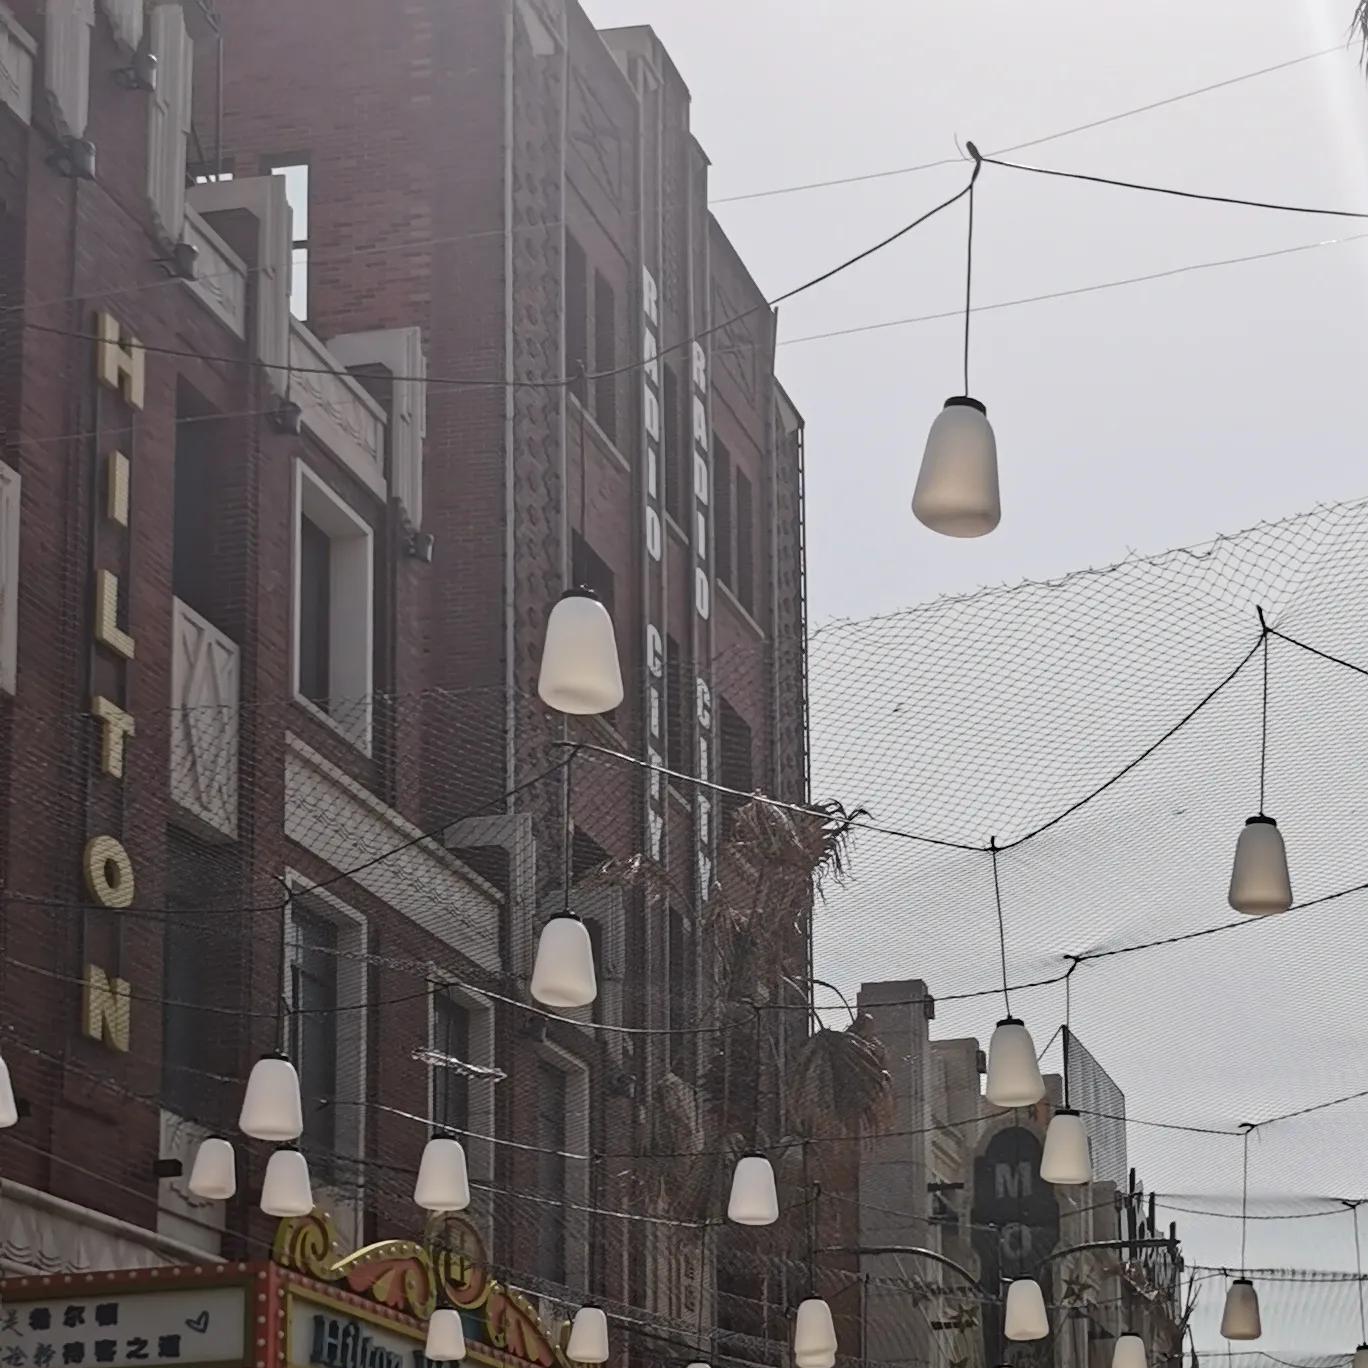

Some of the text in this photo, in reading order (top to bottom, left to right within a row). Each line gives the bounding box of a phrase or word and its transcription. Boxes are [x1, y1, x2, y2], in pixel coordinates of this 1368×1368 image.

[83, 310, 145, 1053] HILTON
[642, 263, 663, 861] RADIO CITY
[692, 339, 712, 901] RADIO CITY
